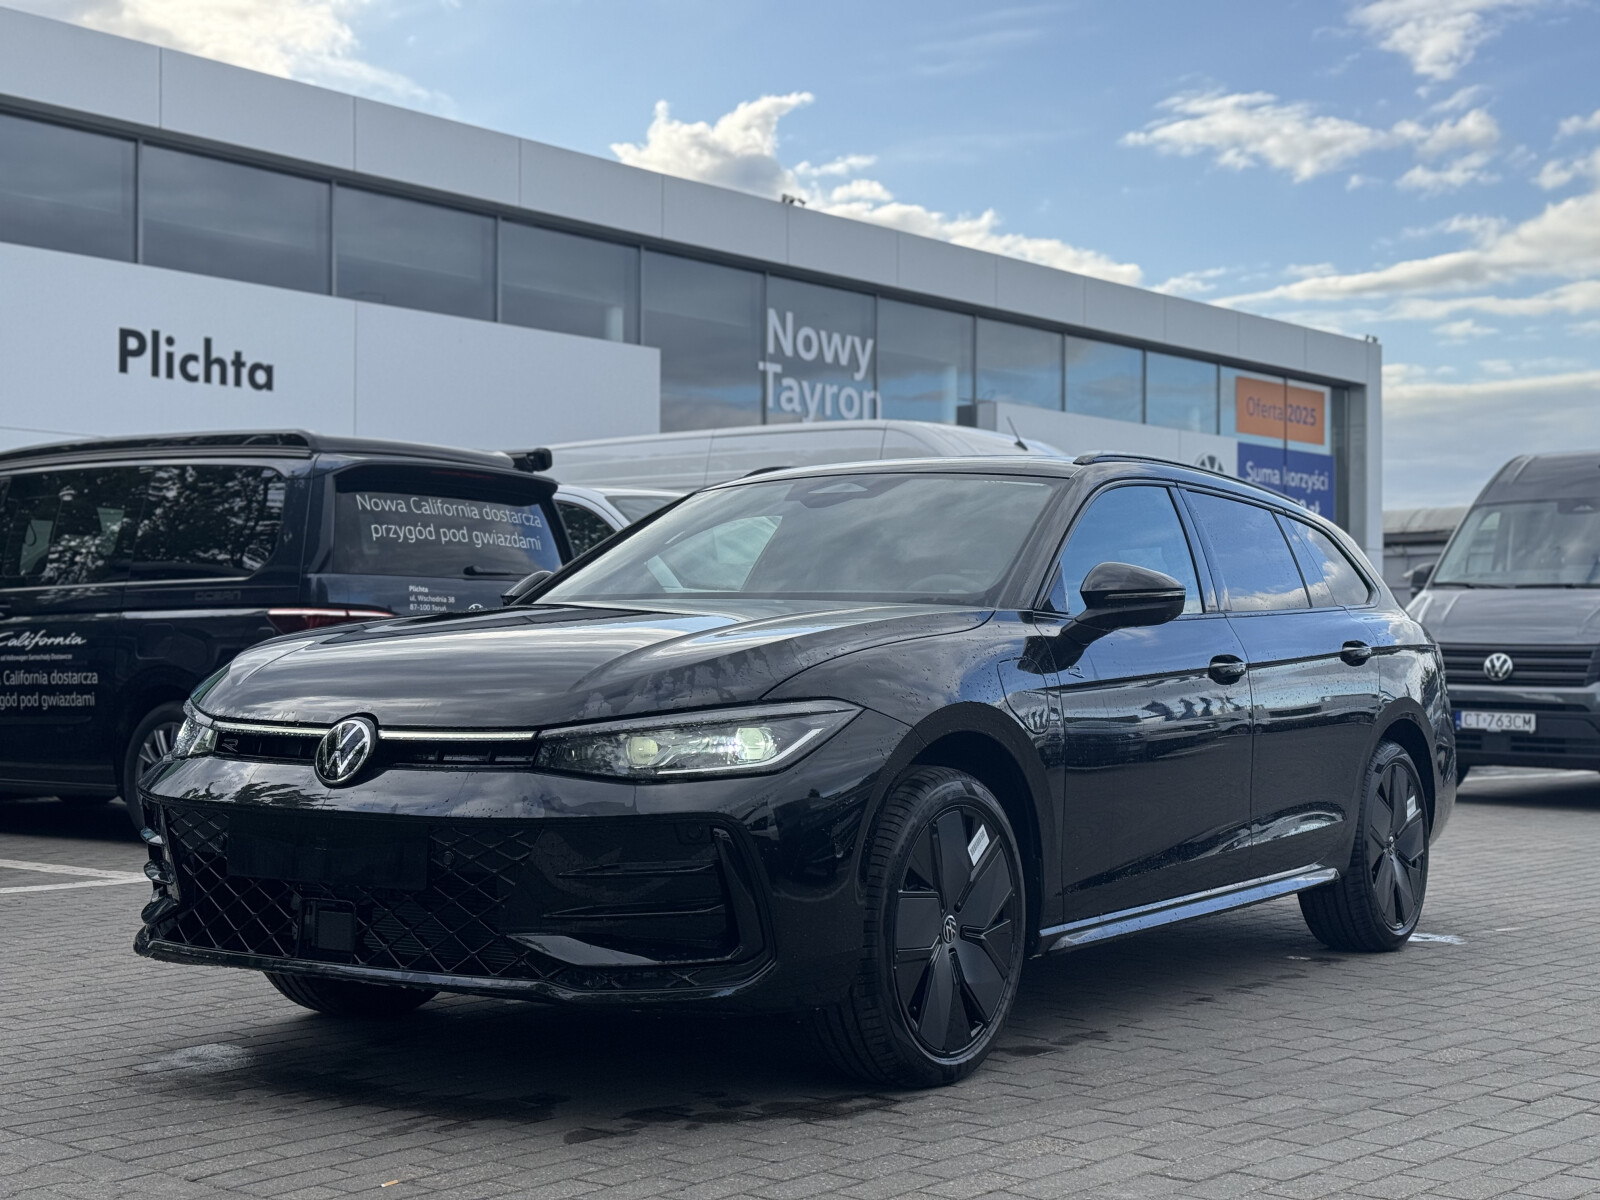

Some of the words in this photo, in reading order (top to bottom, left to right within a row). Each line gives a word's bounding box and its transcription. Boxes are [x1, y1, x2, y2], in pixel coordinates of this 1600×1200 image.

[767, 307, 875, 381] Nowy
[118, 326, 274, 392] Plichta
[758, 360, 883, 423] Tayron
[1245, 396, 1284, 422] Oferta
[1286, 403, 1317, 427] 2025
[1245, 460, 1281, 486] Suma
[355, 494, 408, 513] Nowa
[410, 497, 480, 519] California
[483, 504, 542, 528] dostarcza
[370, 522, 436, 543] przygód
[440, 526, 469, 544] pod
[472, 529, 542, 551] gwiazdami
[408, 585, 429, 593] Plichta
[409, 603, 431, 611] 87-100
[0, 629, 88, 651] California
[3, 669, 48, 685] California
[50, 669, 99, 685] dostarcza
[20, 691, 39, 710] pod
[41, 691, 96, 710] gwiazdami
[1486, 714, 1532, 730] 763CM
